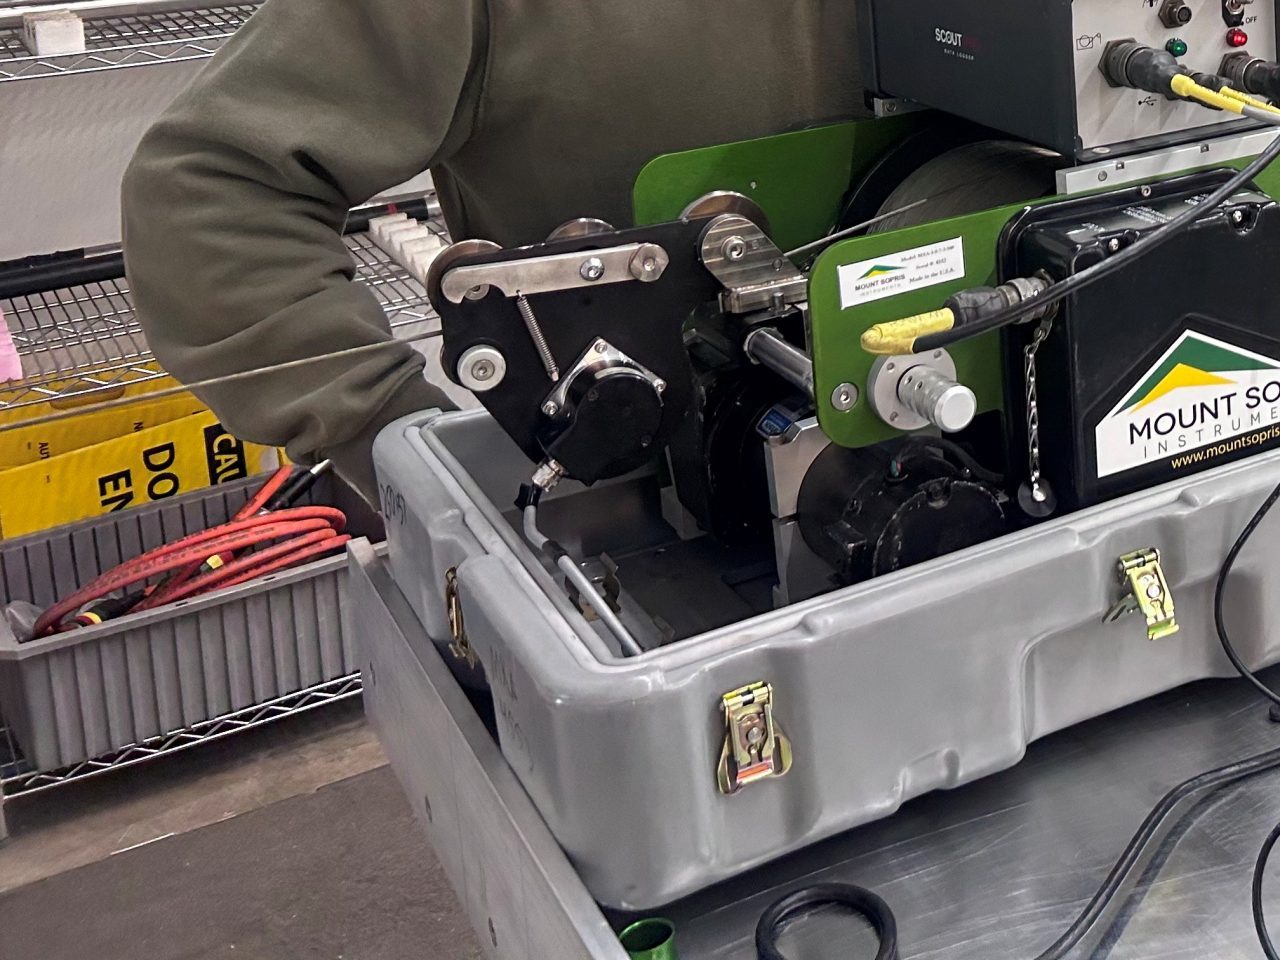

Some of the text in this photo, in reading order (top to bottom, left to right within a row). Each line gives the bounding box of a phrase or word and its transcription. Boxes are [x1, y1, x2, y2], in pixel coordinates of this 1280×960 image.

[1245, 15, 1258, 25] OFF
[934, 27, 963, 47] SCOUT
[854, 273, 906, 292] MOUNT SOPRIS
[1129, 392, 1237, 445] MOUNT
[143, 441, 180, 500] DO
